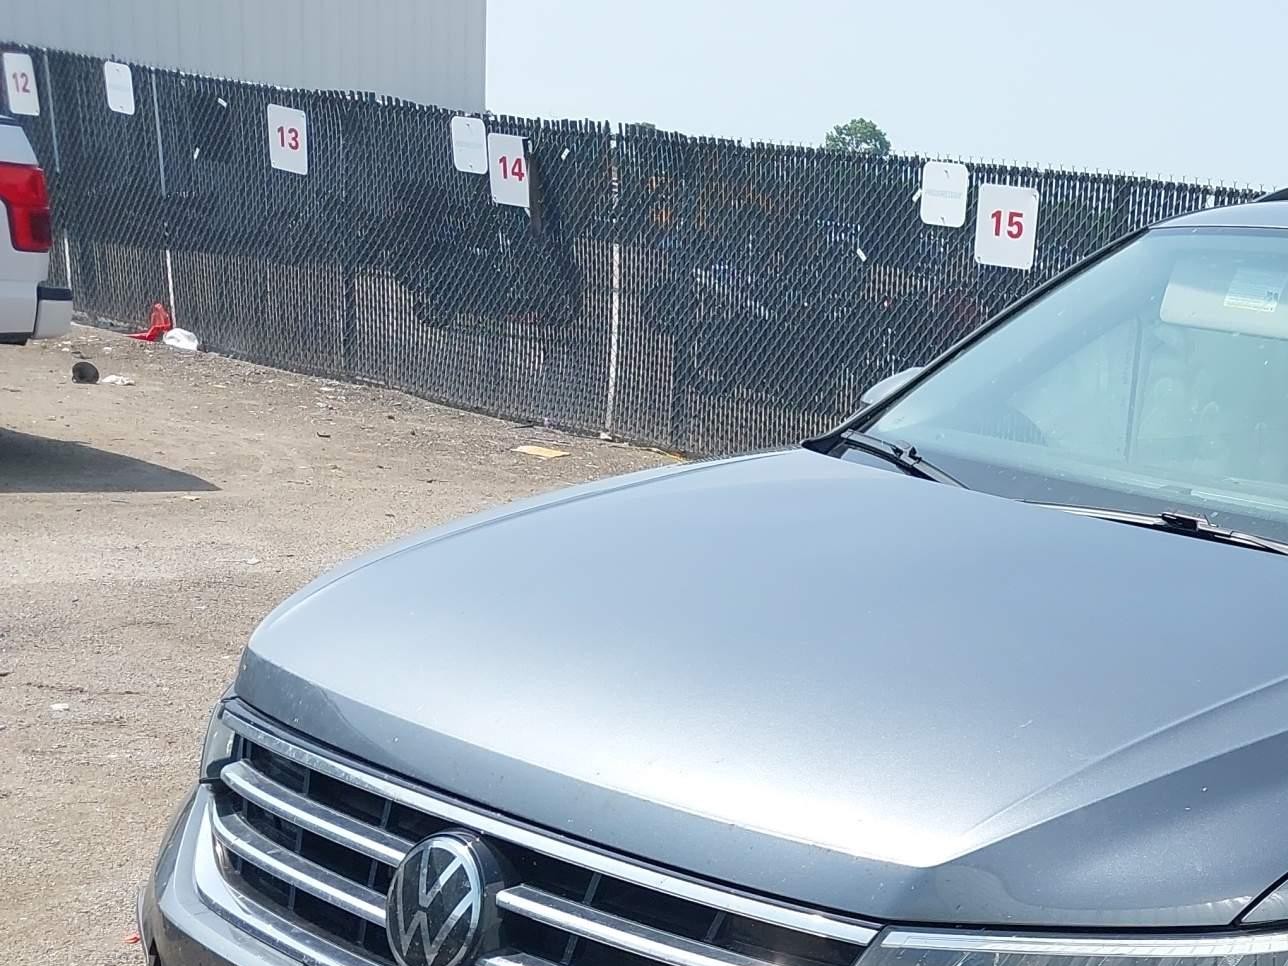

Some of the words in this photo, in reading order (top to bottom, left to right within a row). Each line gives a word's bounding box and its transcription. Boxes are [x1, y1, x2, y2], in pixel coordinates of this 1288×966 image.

[12, 71, 31, 94] 12
[277, 126, 300, 151] 13
[498, 155, 525, 182] 14
[991, 209, 1024, 239] 15
